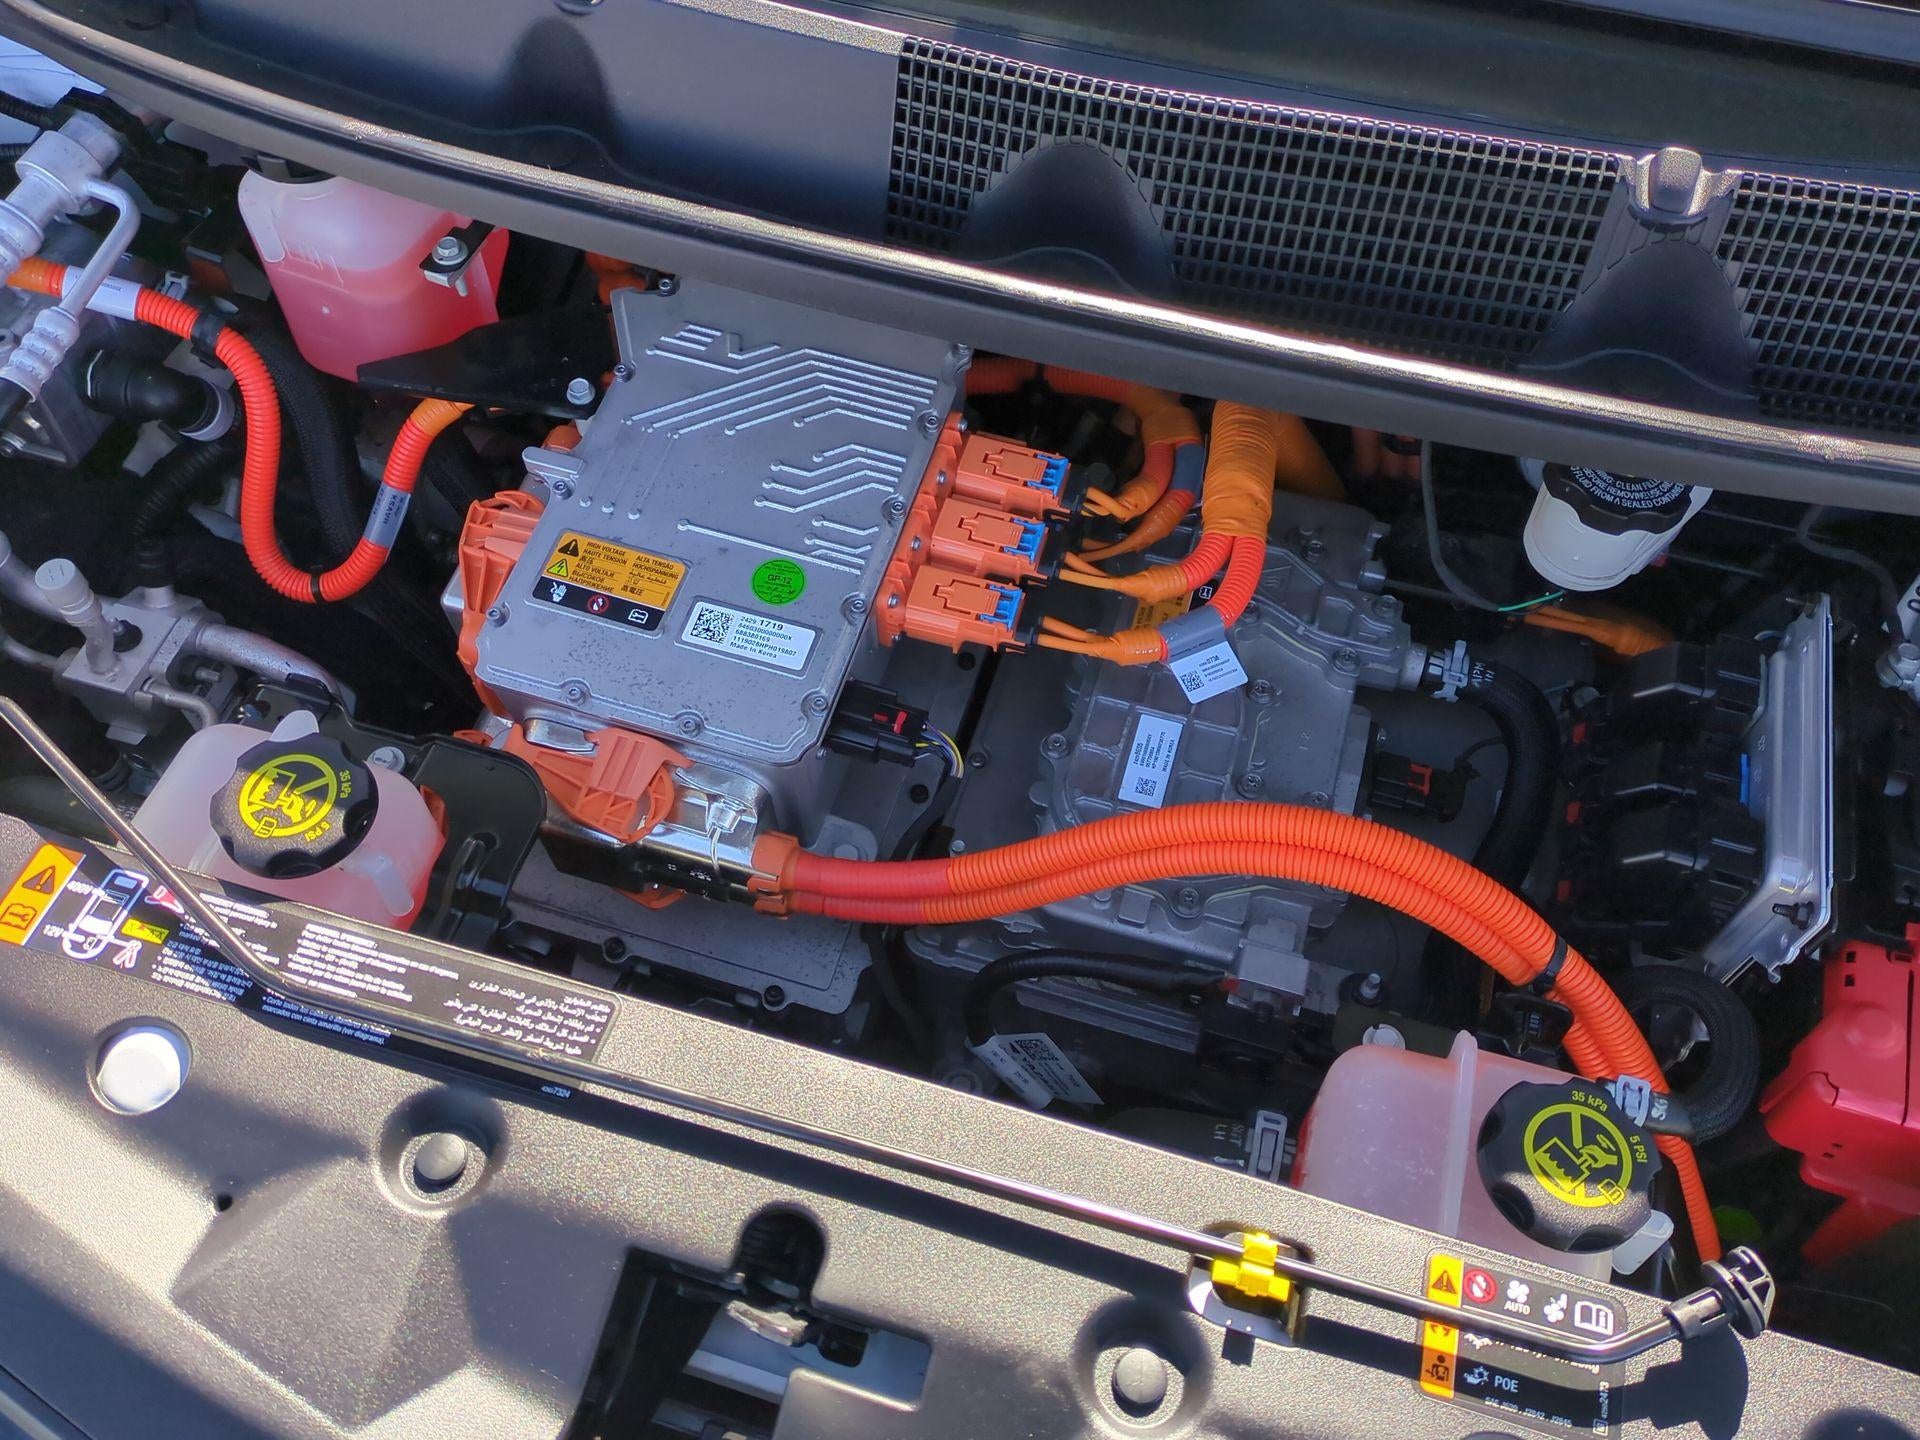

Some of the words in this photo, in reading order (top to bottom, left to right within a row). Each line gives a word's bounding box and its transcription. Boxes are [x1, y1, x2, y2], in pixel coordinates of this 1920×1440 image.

[1583, 467, 1608, 490] BEFORE
[1616, 480, 1642, 491] CLEAN
[1573, 470, 1592, 488] FLUID
[1590, 486, 1613, 502] FROM
[1622, 500, 1653, 508] SEALED
[582, 549, 601, 557] HAUTE
[602, 554, 627, 564] TENSION
[601, 546, 625, 555] VOLTAGE
[571, 570, 604, 582] ВЫСОКОЕ
[631, 563, 679, 579] HOCHSPANNUNG
[767, 573, 792, 584] GP-12
[568, 576, 614, 592] НАПРЯЖЕНИЕ
[758, 619, 783, 630] 1719
[729, 642, 748, 650] Made
[757, 650, 777, 658] Korea
[340, 770, 351, 782] 35
[340, 782, 352, 799] kPa
[305, 828, 323, 842] PSI
[266, 997, 283, 1005] Corte
[282, 1002, 299, 1010] todos
[261, 1005, 291, 1017] marcados
[302, 1016, 318, 1024] cinta
[317, 1020, 342, 1031] amarilla
[341, 1027, 354, 1035] (ver
[353, 1031, 385, 1044] diagrama).
[1572, 1091, 1585, 1102] 35
[1588, 1095, 1608, 1113] kPa
[1629, 1135, 1640, 1143] 5
[1634, 1146, 1648, 1164] PSI
[1504, 1300, 1531, 1315] AUTO
[1494, 1374, 1519, 1393] POE
